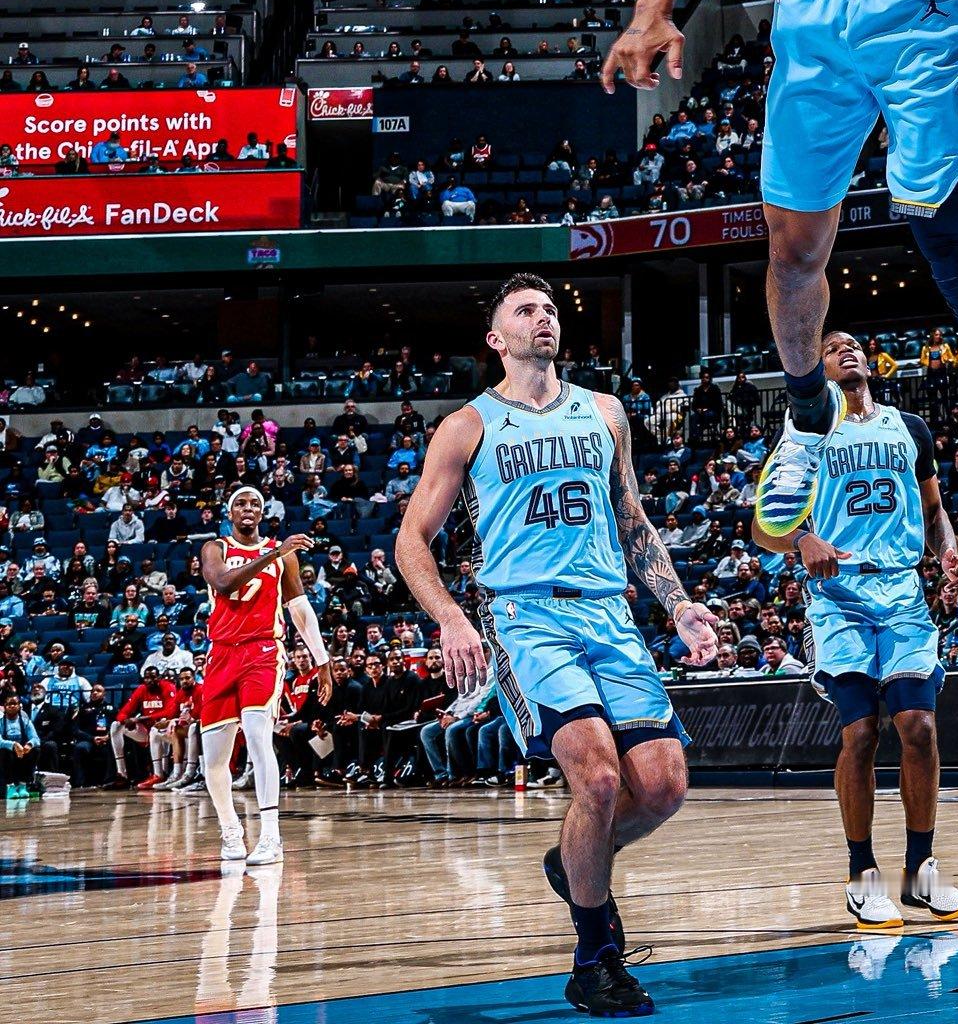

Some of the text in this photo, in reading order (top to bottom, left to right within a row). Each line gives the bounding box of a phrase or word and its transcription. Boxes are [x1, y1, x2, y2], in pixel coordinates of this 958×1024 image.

[310, 98, 373, 118] Chick-fil-A
[25, 112, 212, 136] Score points with
[379, 118, 407, 131] 107A
[15, 142, 52, 160] the
[105, 201, 220, 226] FanDeck
[849, 205, 872, 224] QTR
[650, 217, 690, 248] 70
[722, 222, 768, 240] FOULS:
[495, 432, 603, 484] GRIZZLIES
[825, 441, 908, 479] GRIZZLIES
[524, 481, 592, 529] 46
[845, 478, 897, 517] 23
[229, 578, 263, 602] 7
